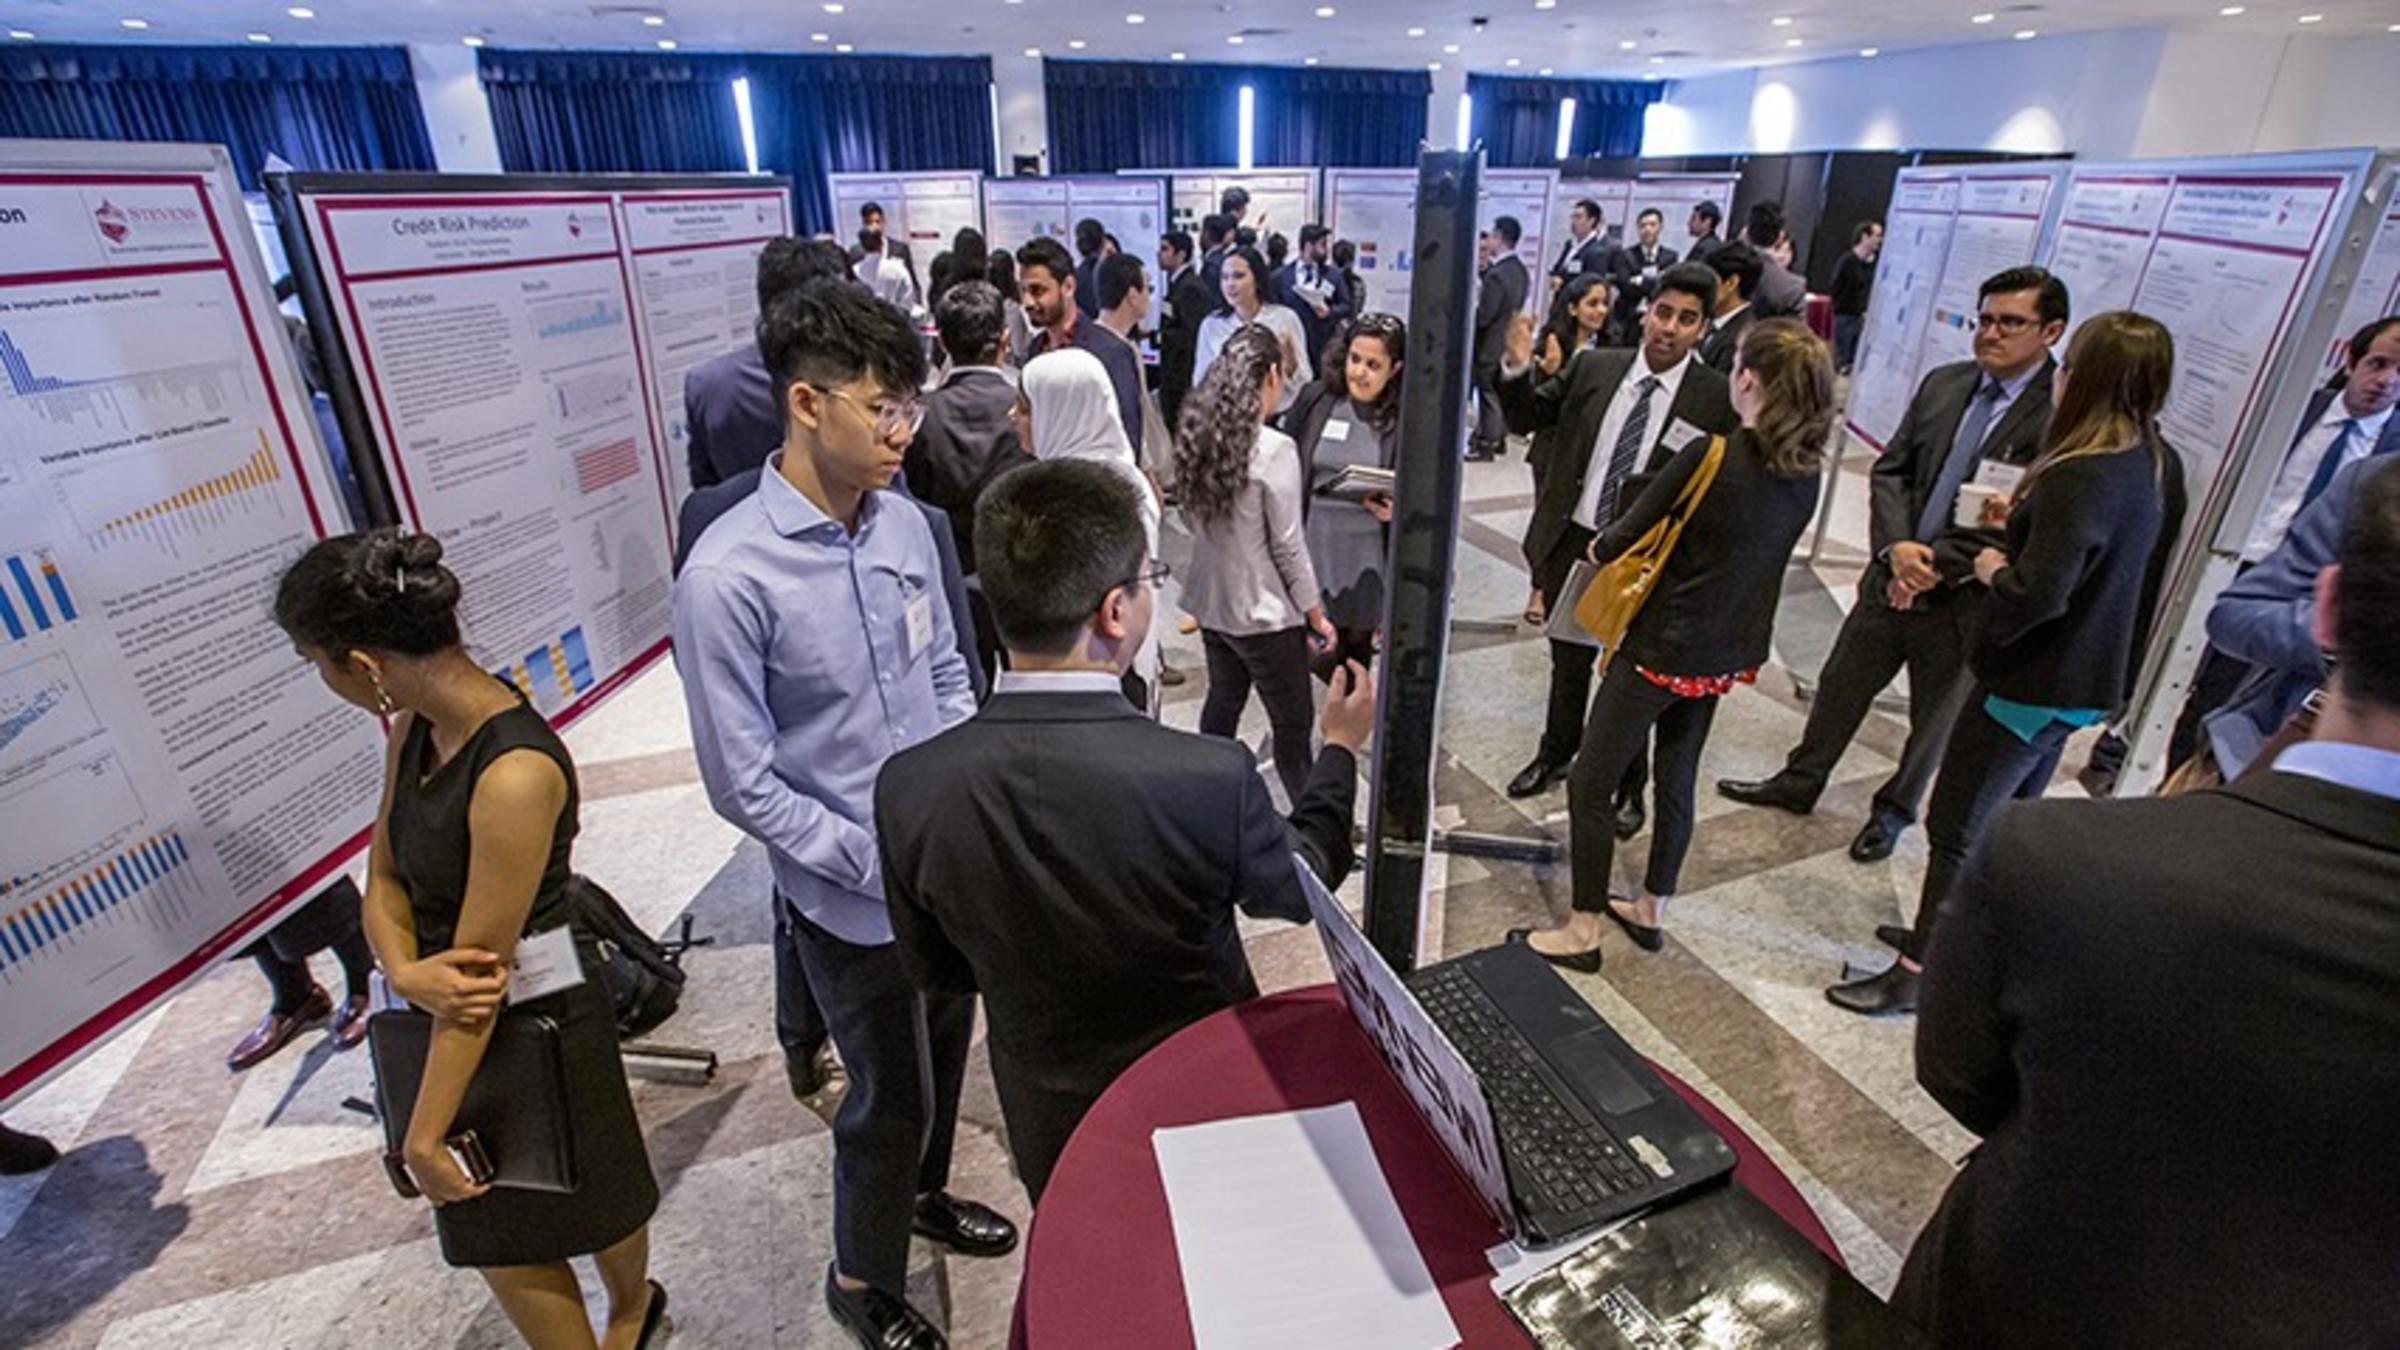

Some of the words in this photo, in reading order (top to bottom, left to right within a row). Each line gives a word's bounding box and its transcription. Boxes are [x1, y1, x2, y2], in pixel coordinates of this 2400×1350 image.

[129, 206, 198, 222] STEVENS
[392, 217, 438, 236] Credit
[439, 216, 467, 232] Risk
[469, 214, 530, 231] Prediction
[368, 292, 437, 310] Introduction
